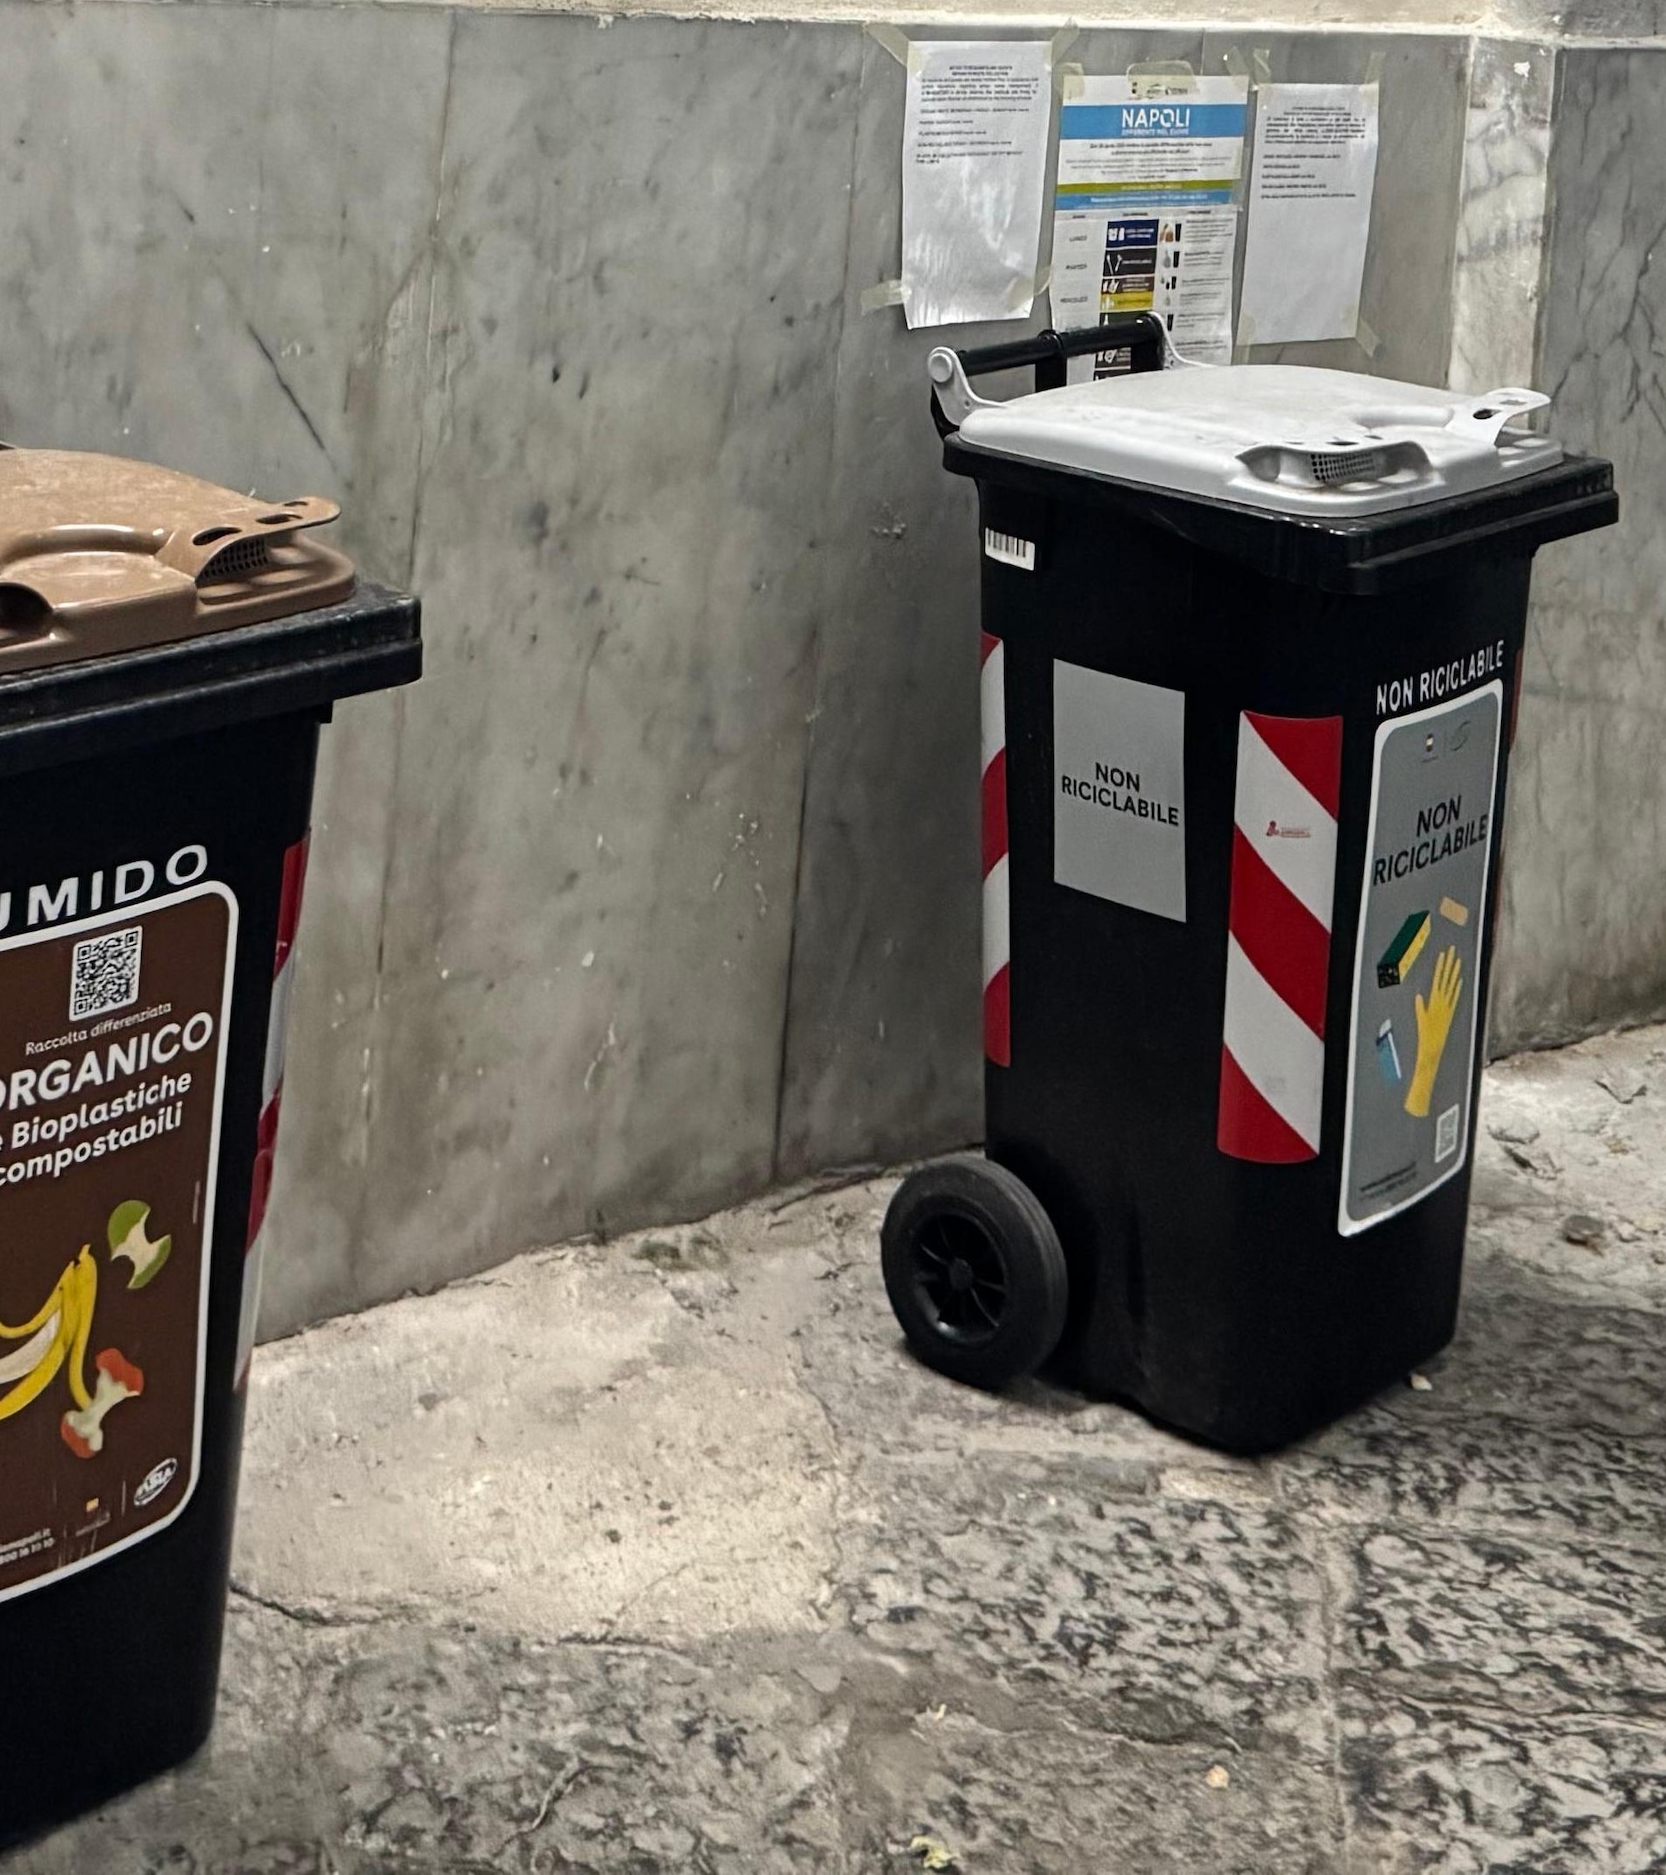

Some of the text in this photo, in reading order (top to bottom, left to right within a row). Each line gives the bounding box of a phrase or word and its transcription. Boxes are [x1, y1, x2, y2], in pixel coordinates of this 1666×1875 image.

[1121, 108, 1191, 128] NAPOLI
[1376, 639, 1505, 716] NON RICICLABILE
[1061, 775, 1180, 827] RICICLABILE
[1095, 762, 1140, 793] NON
[1415, 794, 1462, 838] NON
[1373, 813, 1488, 887] RICICLABILE
[25, 1001, 172, 1056] Raccolta differenziata
[11, 1072, 192, 1151] Bioplastiche
